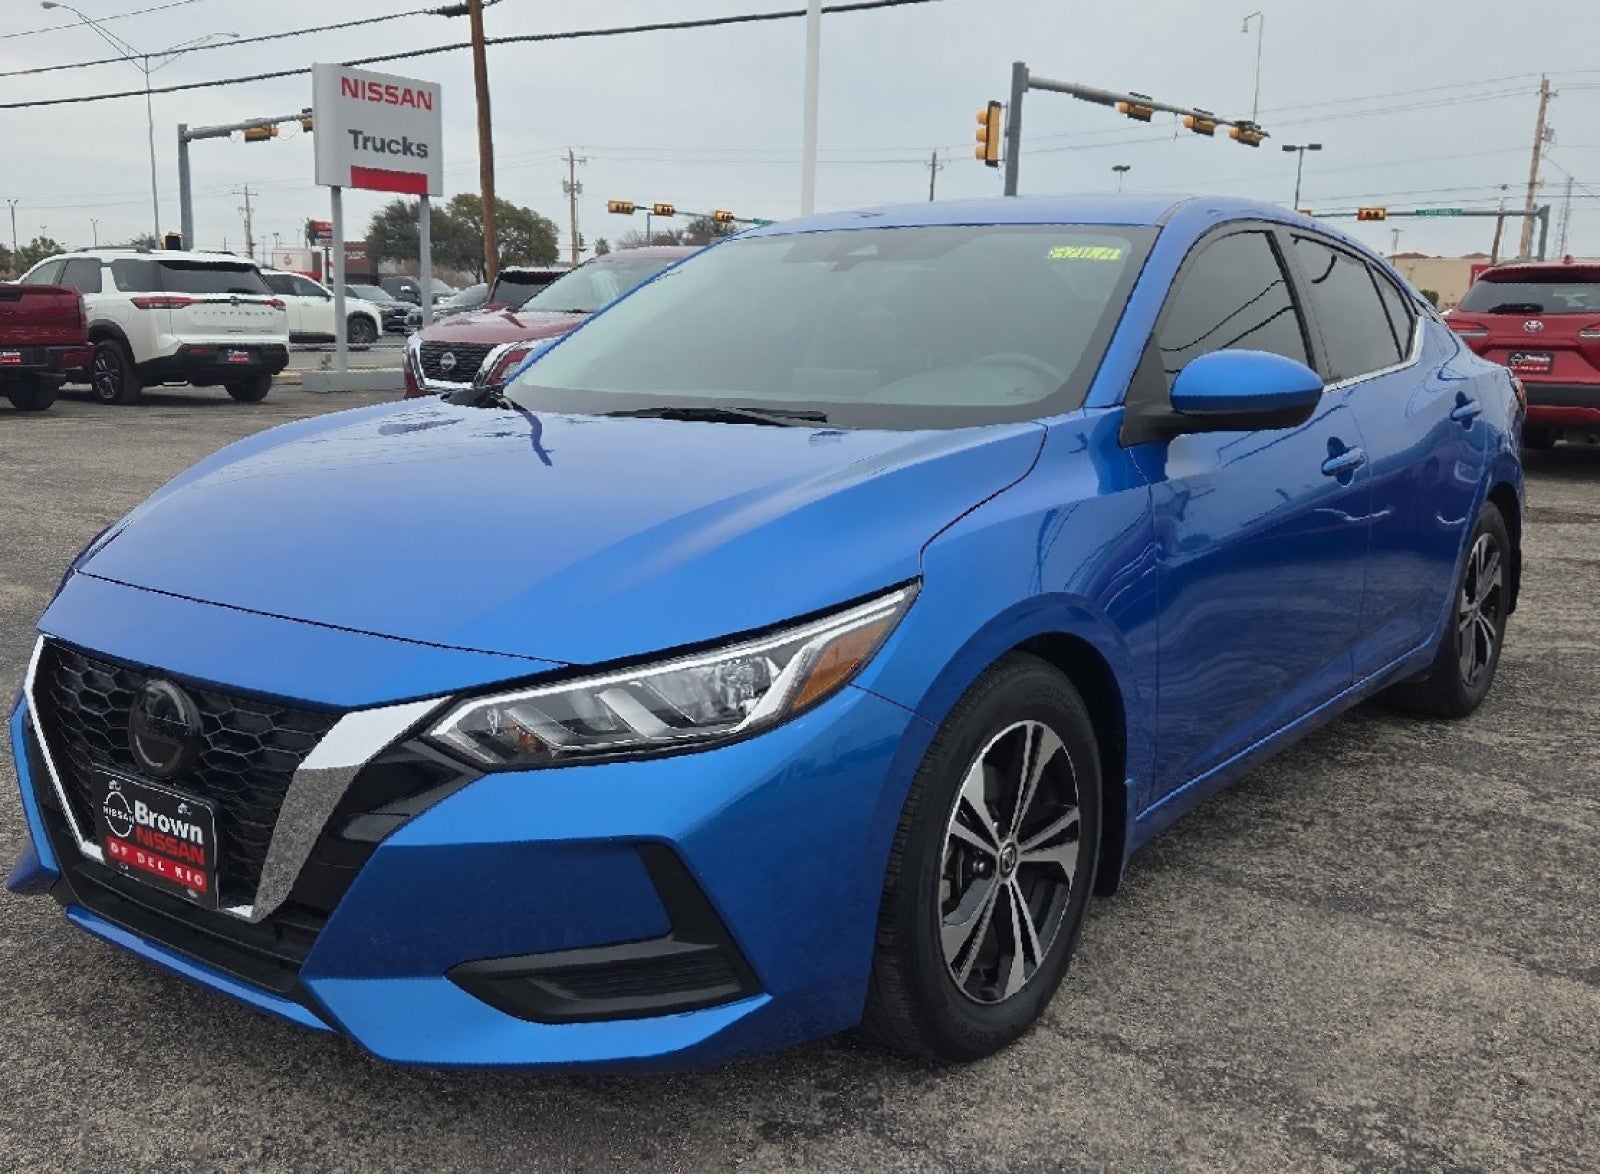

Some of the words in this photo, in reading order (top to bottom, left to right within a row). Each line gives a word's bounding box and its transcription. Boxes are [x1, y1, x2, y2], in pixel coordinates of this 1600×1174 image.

[341, 76, 432, 111] NISSAN
[348, 128, 429, 159] Trucks
[134, 799, 204, 845] Brown
[110, 842, 129, 856] OF
[136, 851, 165, 872] DEL
[174, 865, 203, 886] RIO
[135, 824, 206, 866] NISSAN
